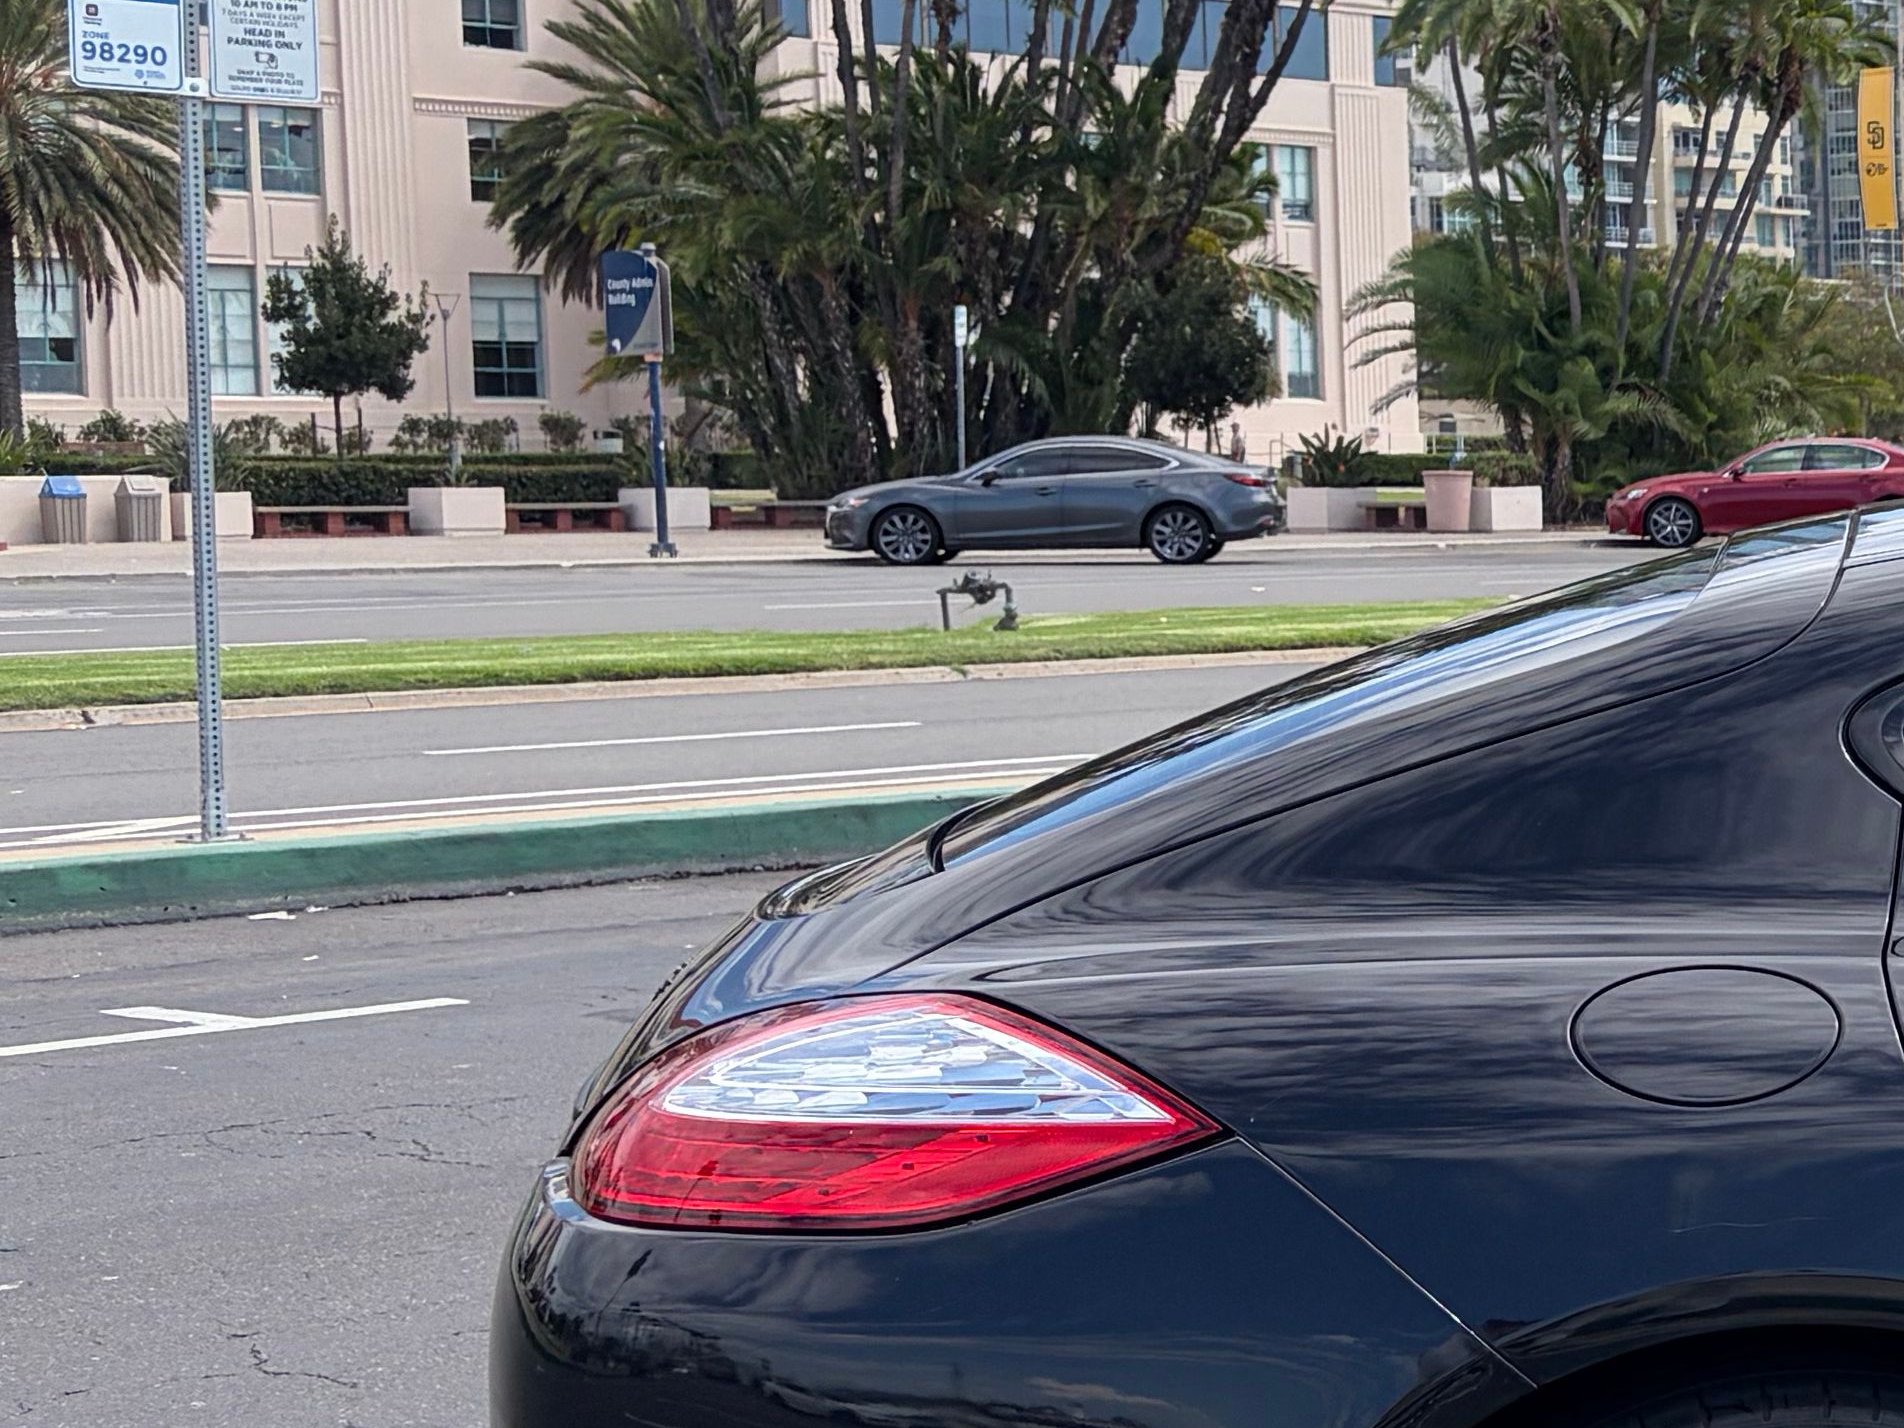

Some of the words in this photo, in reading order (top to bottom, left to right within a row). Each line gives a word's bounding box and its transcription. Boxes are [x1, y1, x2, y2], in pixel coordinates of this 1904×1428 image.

[230, 0, 240, 8] 10
[243, 0, 258, 9] AM
[260, 2, 274, 10] TO
[82, 30, 110, 40] ZONE
[244, 28, 272, 38] HEAD
[274, 30, 286, 38] IN
[227, 36, 272, 48] PARKING
[274, 40, 303, 50] ONLY
[81, 40, 167, 66] 98290
